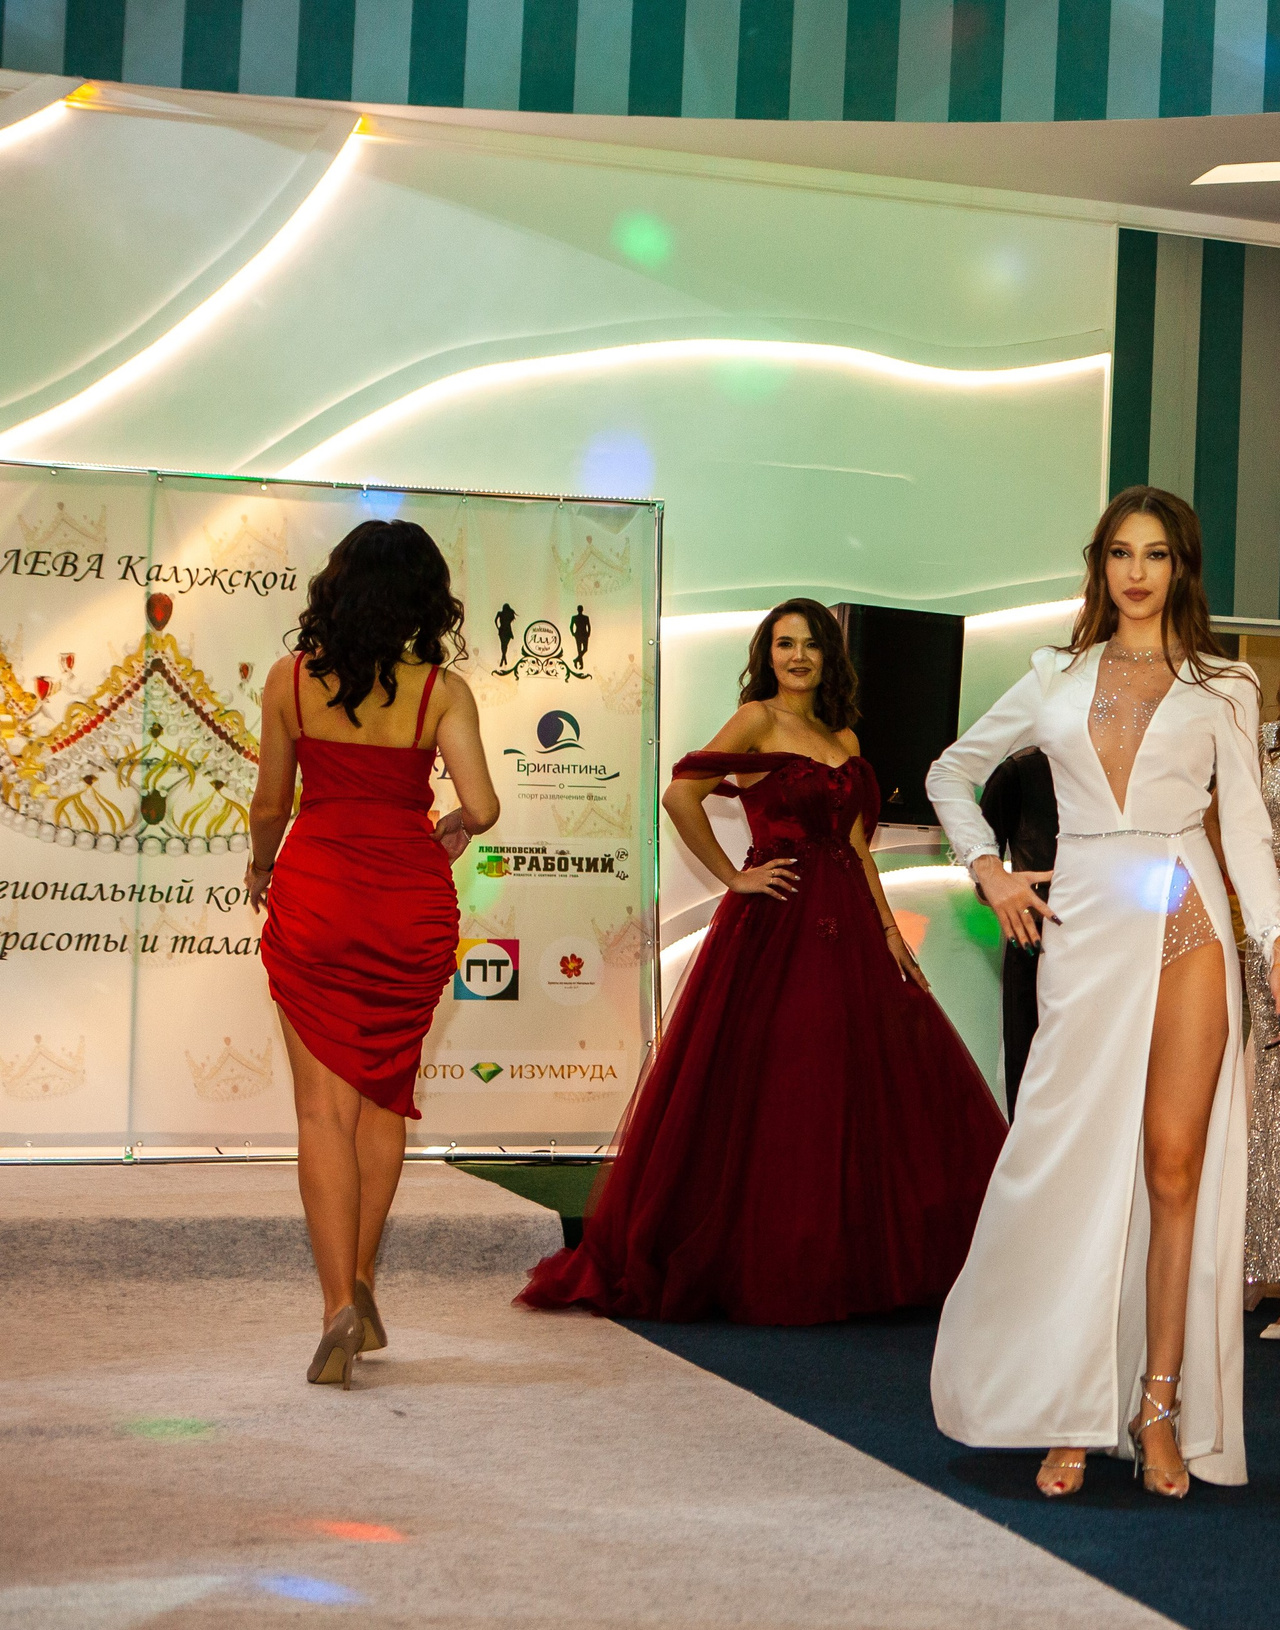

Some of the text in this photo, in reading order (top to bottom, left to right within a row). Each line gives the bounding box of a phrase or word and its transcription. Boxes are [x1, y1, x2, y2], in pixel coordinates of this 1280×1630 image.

[117, 554, 298, 597] Калужской
[516, 759, 607, 777] Бригантина
[517, 793, 539, 801] спорт
[478, 845, 547, 854] ЛЮДИНОВСКИЙ
[513, 854, 615, 873] РАБОЧИЙ
[0, 930, 128, 960] расоты
[139, 932, 159, 953] и
[466, 959, 509, 983] ПТ
[509, 1063, 618, 1083] ИЗУМРУДА
